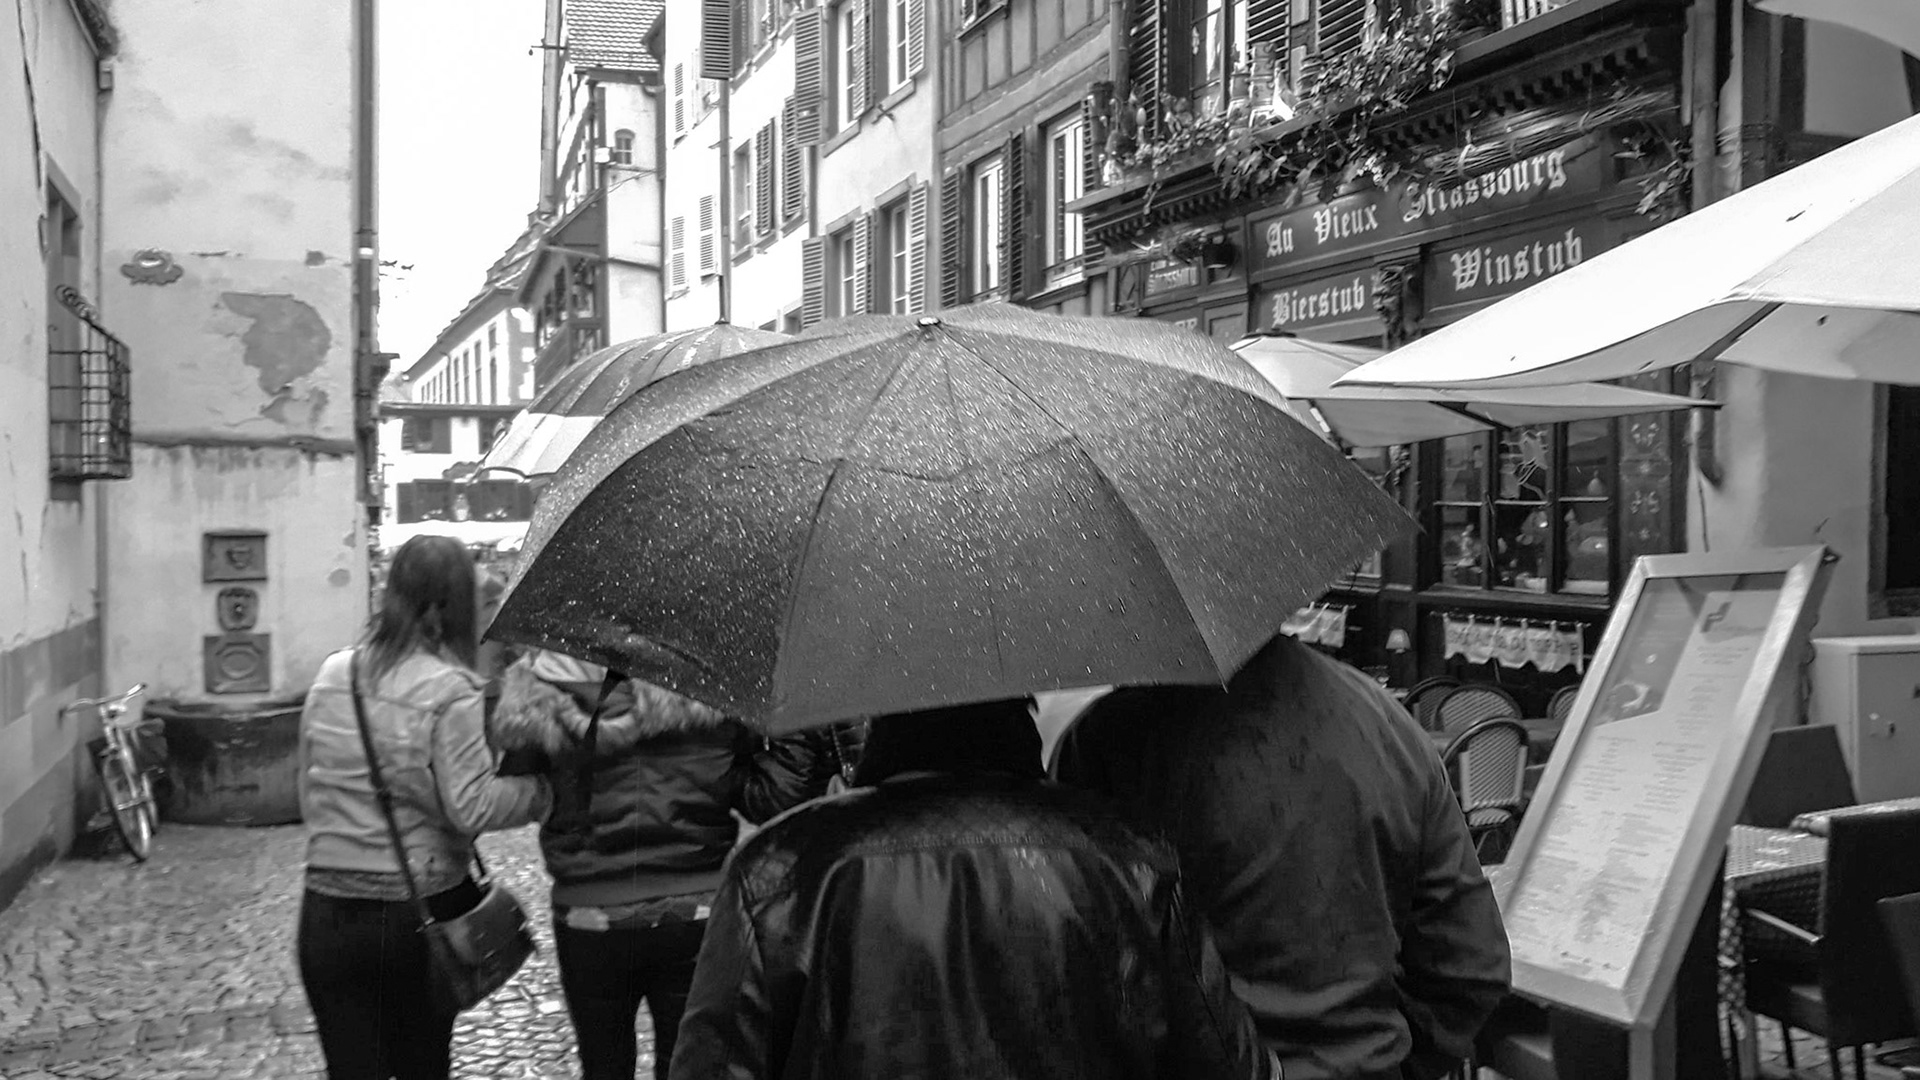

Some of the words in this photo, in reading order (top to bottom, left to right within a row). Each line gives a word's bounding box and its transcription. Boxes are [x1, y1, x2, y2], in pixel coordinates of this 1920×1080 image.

[1266, 221, 1294, 258] Au
[1312, 204, 1379, 245] Vieux
[1450, 227, 1582, 291] Winstub
[1271, 277, 1365, 328] Bierstub
